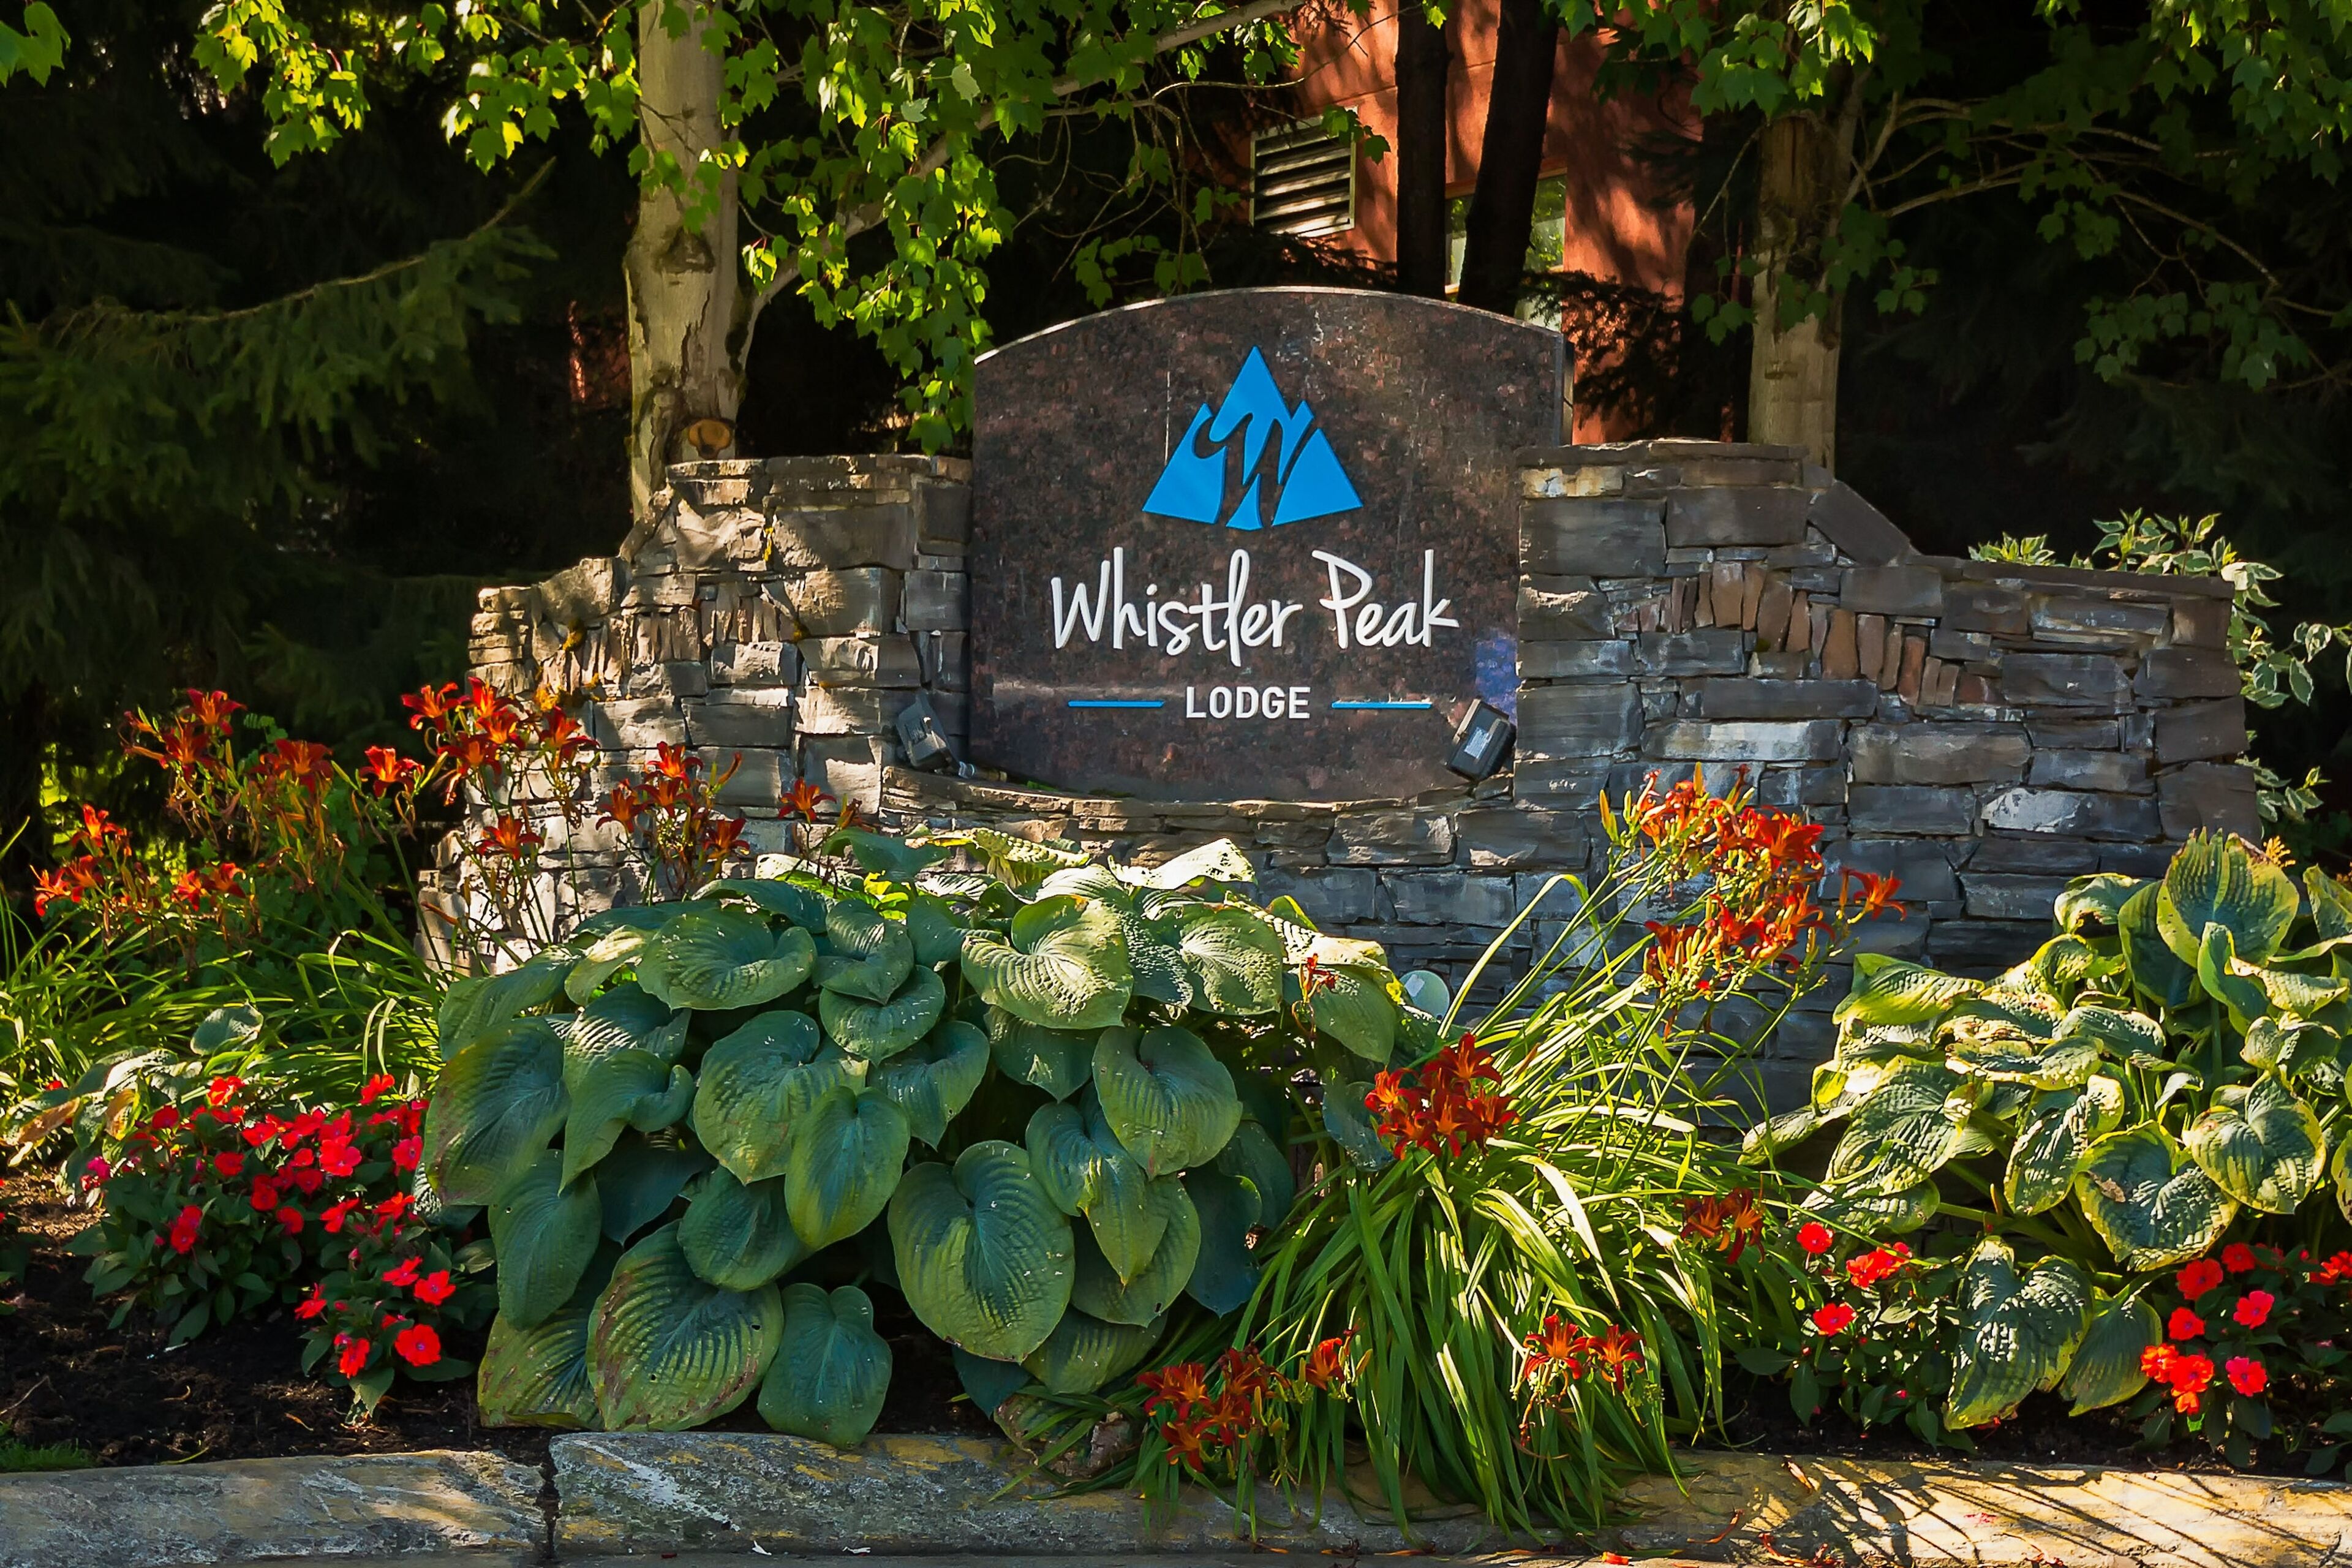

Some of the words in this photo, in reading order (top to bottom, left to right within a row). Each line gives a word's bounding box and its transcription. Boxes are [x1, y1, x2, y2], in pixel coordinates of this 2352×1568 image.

[1051, 547, 1303, 666] Whistler
[1312, 549, 1460, 649] Peak
[1186, 686, 1311, 719] LODGE
